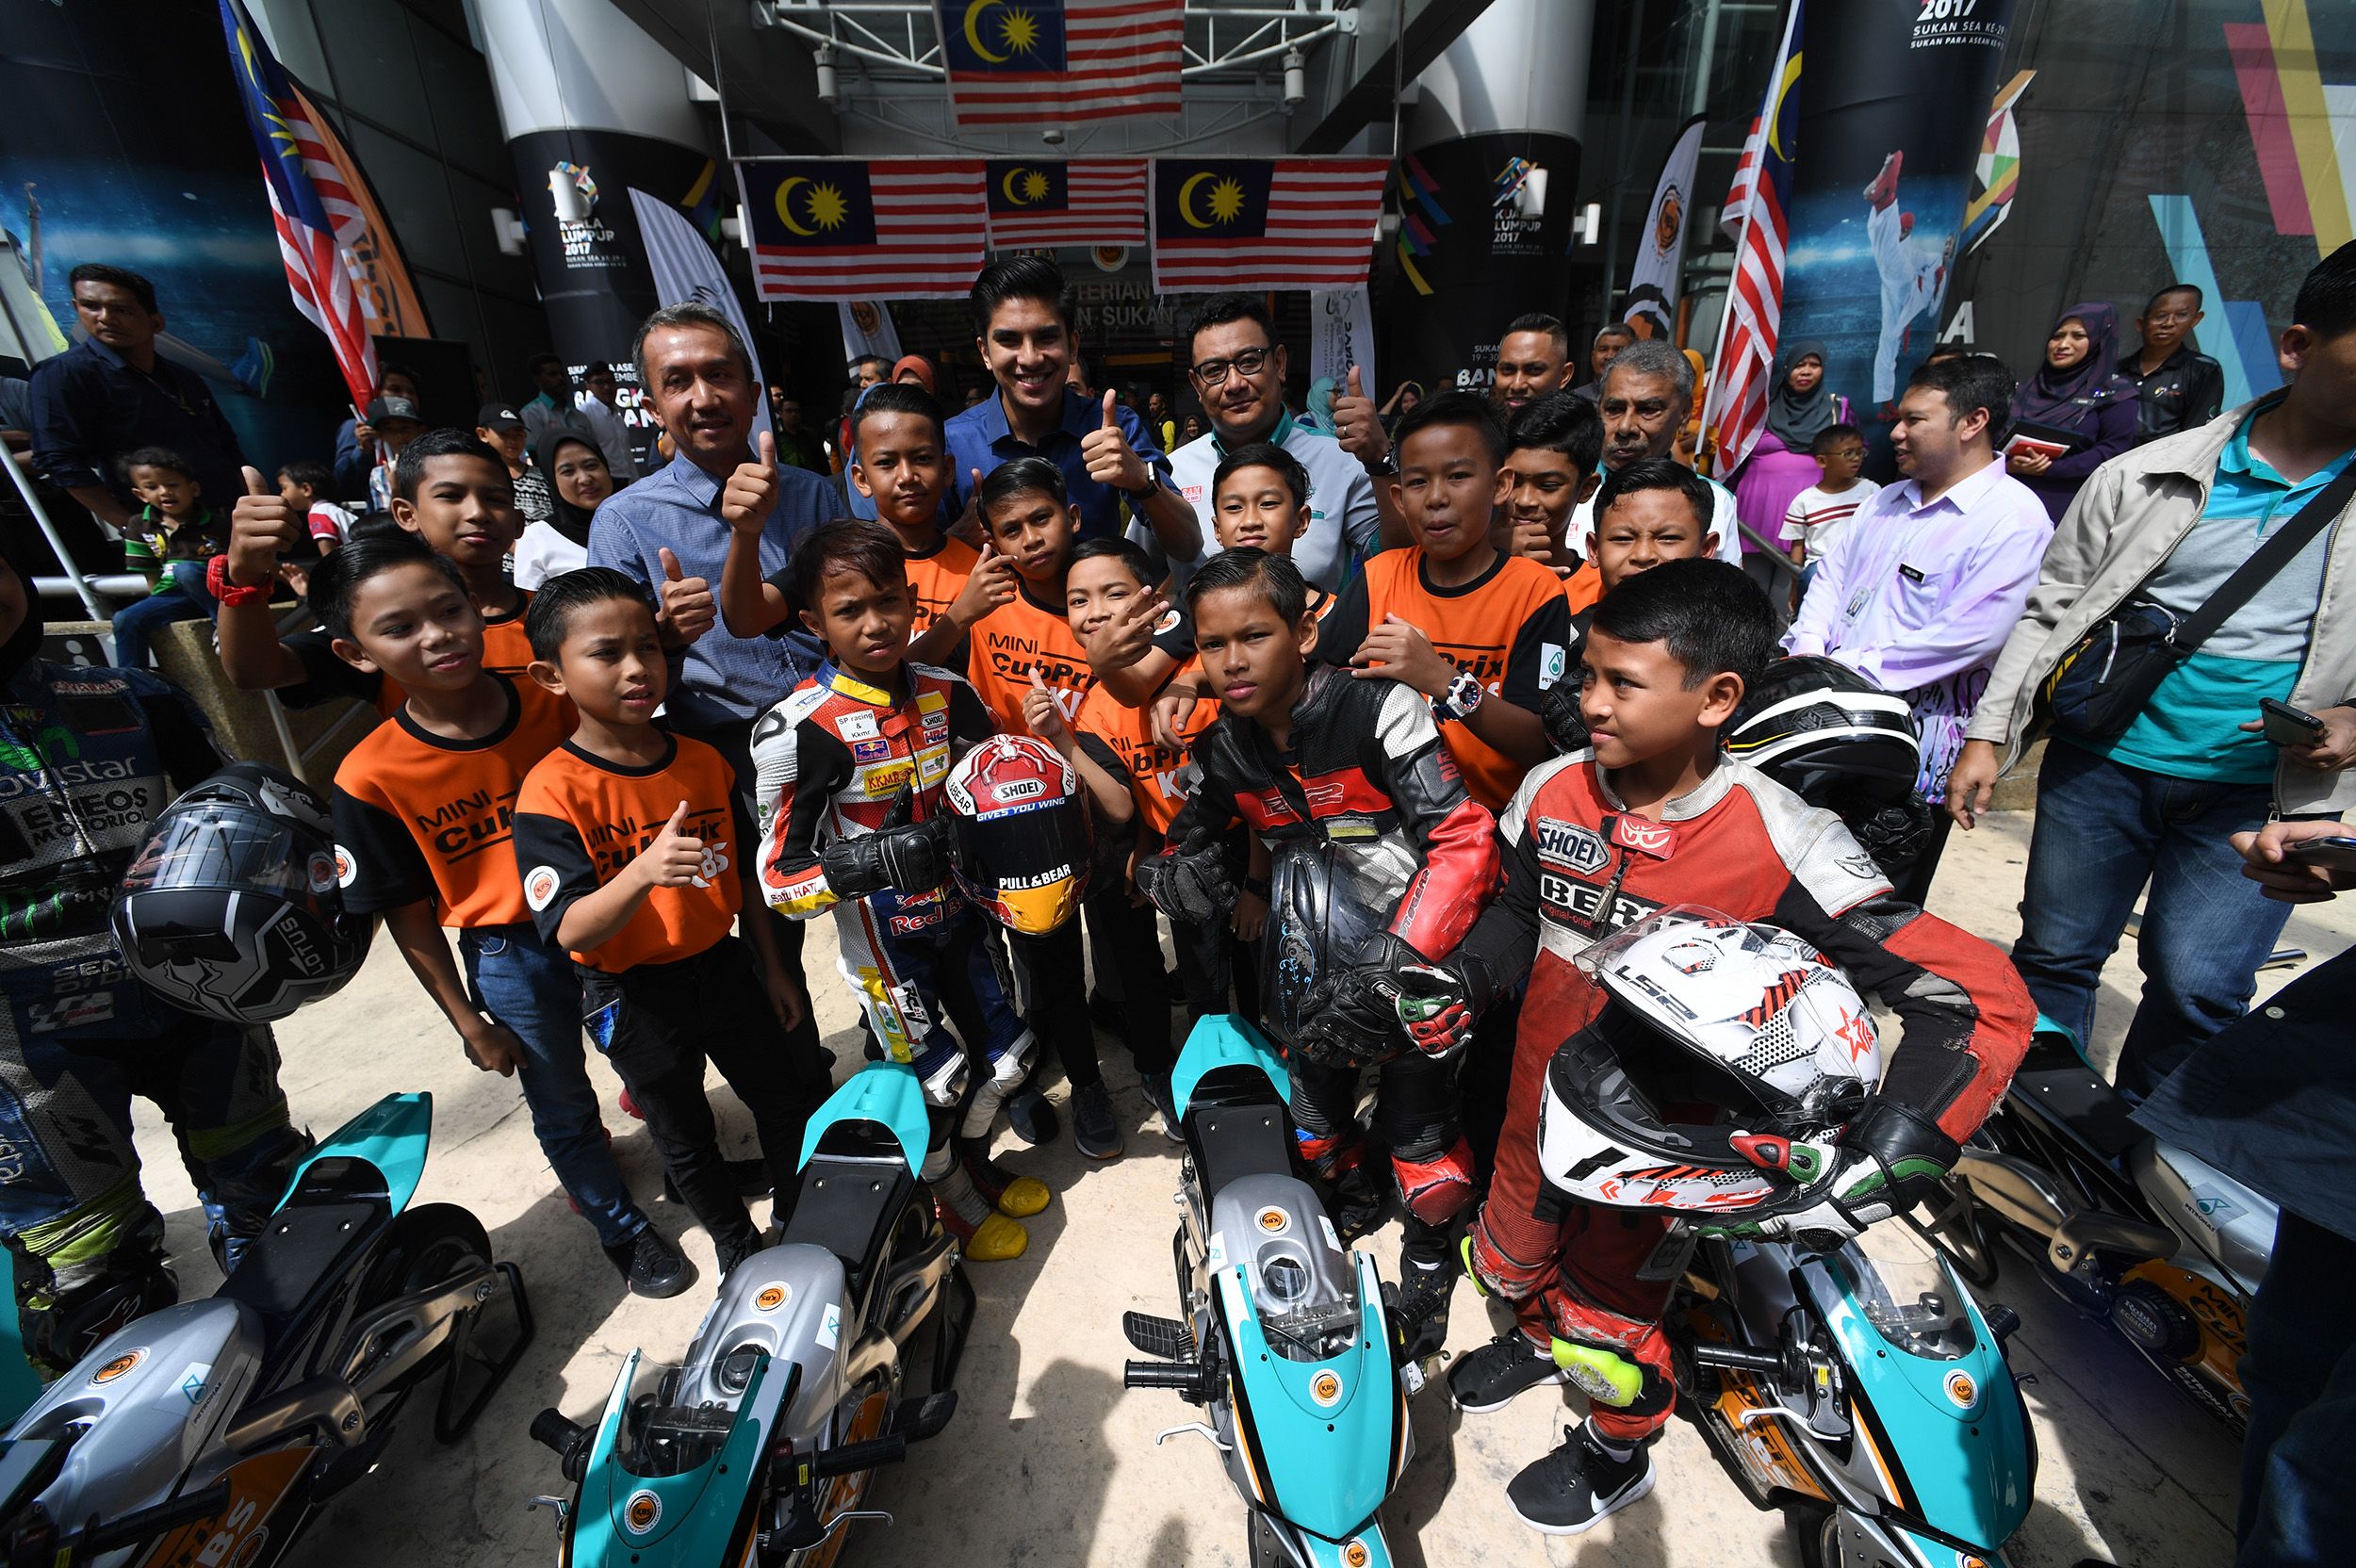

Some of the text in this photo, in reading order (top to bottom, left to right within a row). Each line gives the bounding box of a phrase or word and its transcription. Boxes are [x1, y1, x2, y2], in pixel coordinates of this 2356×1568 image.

[1913, 23, 1957, 36] SUKAN
[1962, 21, 1981, 31] SEA
[1910, 38, 1942, 48] SUKAN
[1494, 220, 1542, 231] LUMPUR
[561, 230, 615, 243] LUMPUR
[1494, 232, 1520, 242] 2017
[564, 241, 591, 255] 2017
[1102, 306, 1175, 326] SUKAN
[990, 632, 1038, 654] MINI
[851, 712, 873, 723] racing
[925, 715, 943, 726] SHOEI
[852, 729, 870, 738] Kkmr
[925, 728, 947, 743] HRC
[1001, 781, 1039, 799] SHOEI
[415, 789, 492, 833] MINI
[976, 797, 1066, 822] GIVES YOU WING
[1537, 826, 1597, 865] SHOEI
[889, 904, 943, 937] Red
[282, 917, 325, 976] LOTUS
[1614, 965, 1698, 1023] LS2
[2184, 1202, 2216, 1233] PETRONAS
[2179, 1366, 2234, 1419] PETRONAS
